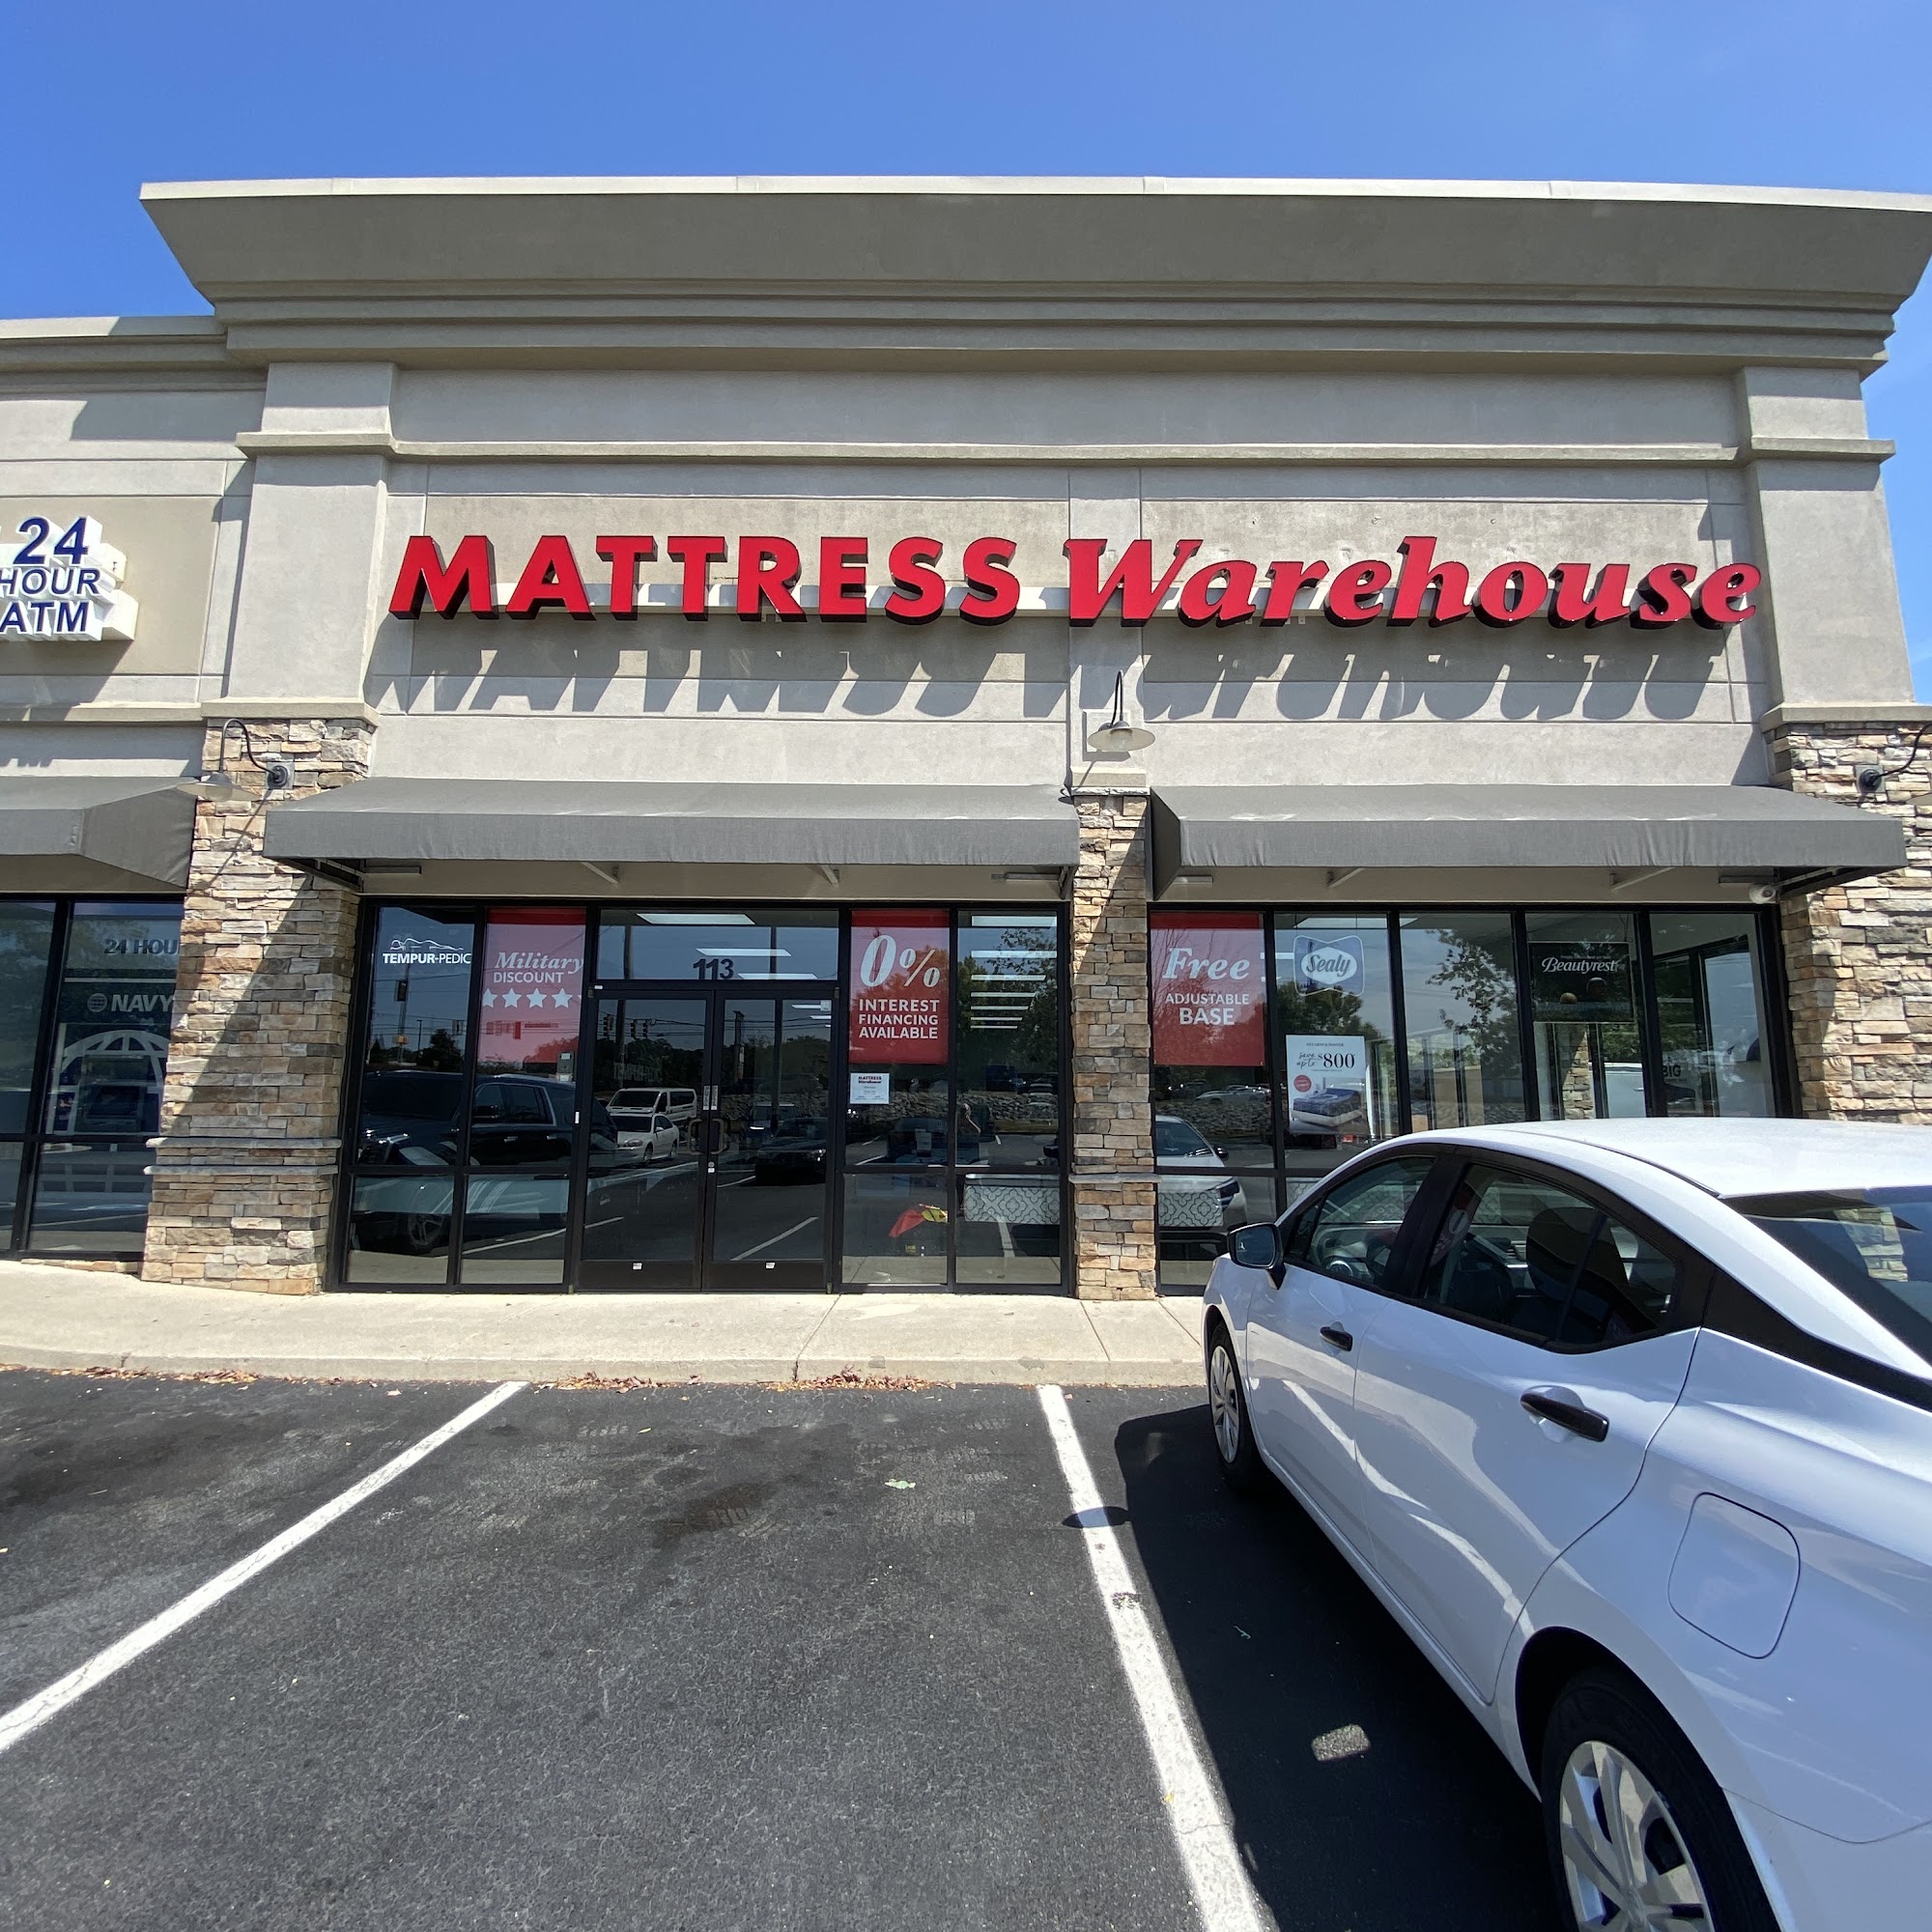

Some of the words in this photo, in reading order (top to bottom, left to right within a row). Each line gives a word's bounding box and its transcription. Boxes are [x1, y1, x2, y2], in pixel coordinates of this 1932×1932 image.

[13, 516, 88, 565] 24
[0, 567, 100, 595] HOUR
[388, 534, 1021, 621] MATTRESS
[1063, 535, 1761, 625] Warehouse
[0, 601, 88, 633] ATM
[104, 939, 128, 954] 24
[133, 939, 180, 954] HOU
[383, 952, 471, 964] TEMPUR-PEDIC
[495, 952, 583, 975] Military
[860, 934, 940, 988] 0%
[1162, 948, 1250, 980] Free
[1306, 954, 1350, 977] Sealy
[1541, 956, 1617, 974] Beautyrest
[494, 972, 564, 983] DISCOUNT
[693, 958, 734, 980] 113
[111, 994, 174, 1012] NAVY
[859, 999, 940, 1012] INTEREST
[1165, 993, 1250, 1006] ADJUSTABLE
[859, 1014, 939, 1026] FINANCING
[1179, 1008, 1236, 1026] BASE
[859, 1027, 938, 1039] AVAILABLE
